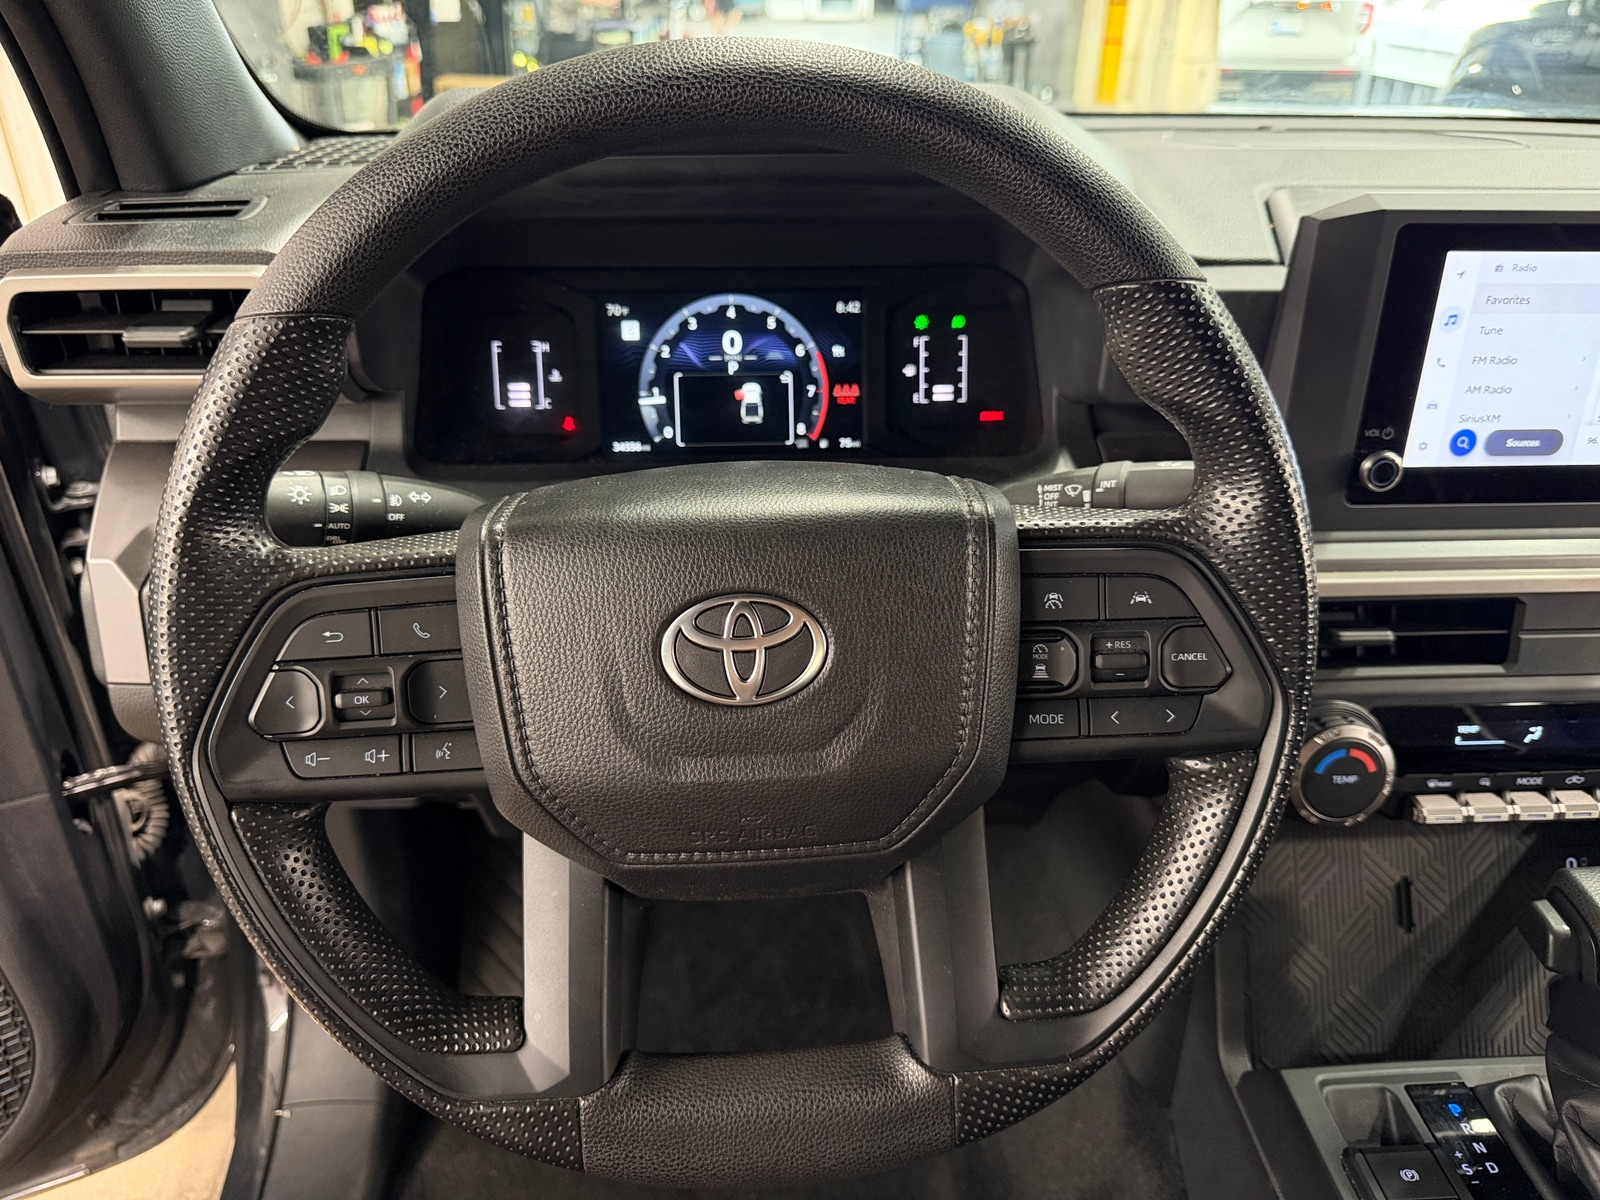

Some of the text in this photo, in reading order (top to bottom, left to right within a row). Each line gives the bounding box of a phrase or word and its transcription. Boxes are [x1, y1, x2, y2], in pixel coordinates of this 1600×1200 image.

[1511, 264, 1538, 273] Radio
[1485, 295, 1532, 306] Favorites
[726, 305, 736, 319] 4
[687, 316, 698, 331] 3
[767, 316, 777, 330] 5
[1479, 326, 1504, 336] Tune
[721, 330, 743, 355] 0
[660, 344, 670, 358] 2
[795, 343, 806, 358] 6
[1472, 355, 1518, 366] FM Radio
[727, 360, 739, 376] P
[806, 384, 817, 398] 7
[1465, 384, 1513, 395] AM Radio
[1458, 413, 1501, 423] SiriusXM
[663, 425, 674, 439] 0
[796, 422, 807, 436] 8
[1363, 428, 1381, 438] VOL
[1504, 437, 1542, 448] Sources
[1043, 484, 1064, 493] MIST
[1100, 479, 1118, 488] INT
[1043, 493, 1060, 501] OFF
[387, 513, 406, 522] OFF
[327, 522, 351, 531] AUTO
[1171, 652, 1208, 662] CANCEL
[353, 694, 370, 706] OK
[1028, 713, 1065, 725] MODE
[1331, 774, 1359, 785] TEMP
[1516, 776, 1544, 786] MODE
[690, 824, 819, 845] SRS AIRBAG
[1460, 1122, 1476, 1135] R
[1472, 1141, 1488, 1154] N
[1461, 1162, 1499, 1175] S D
